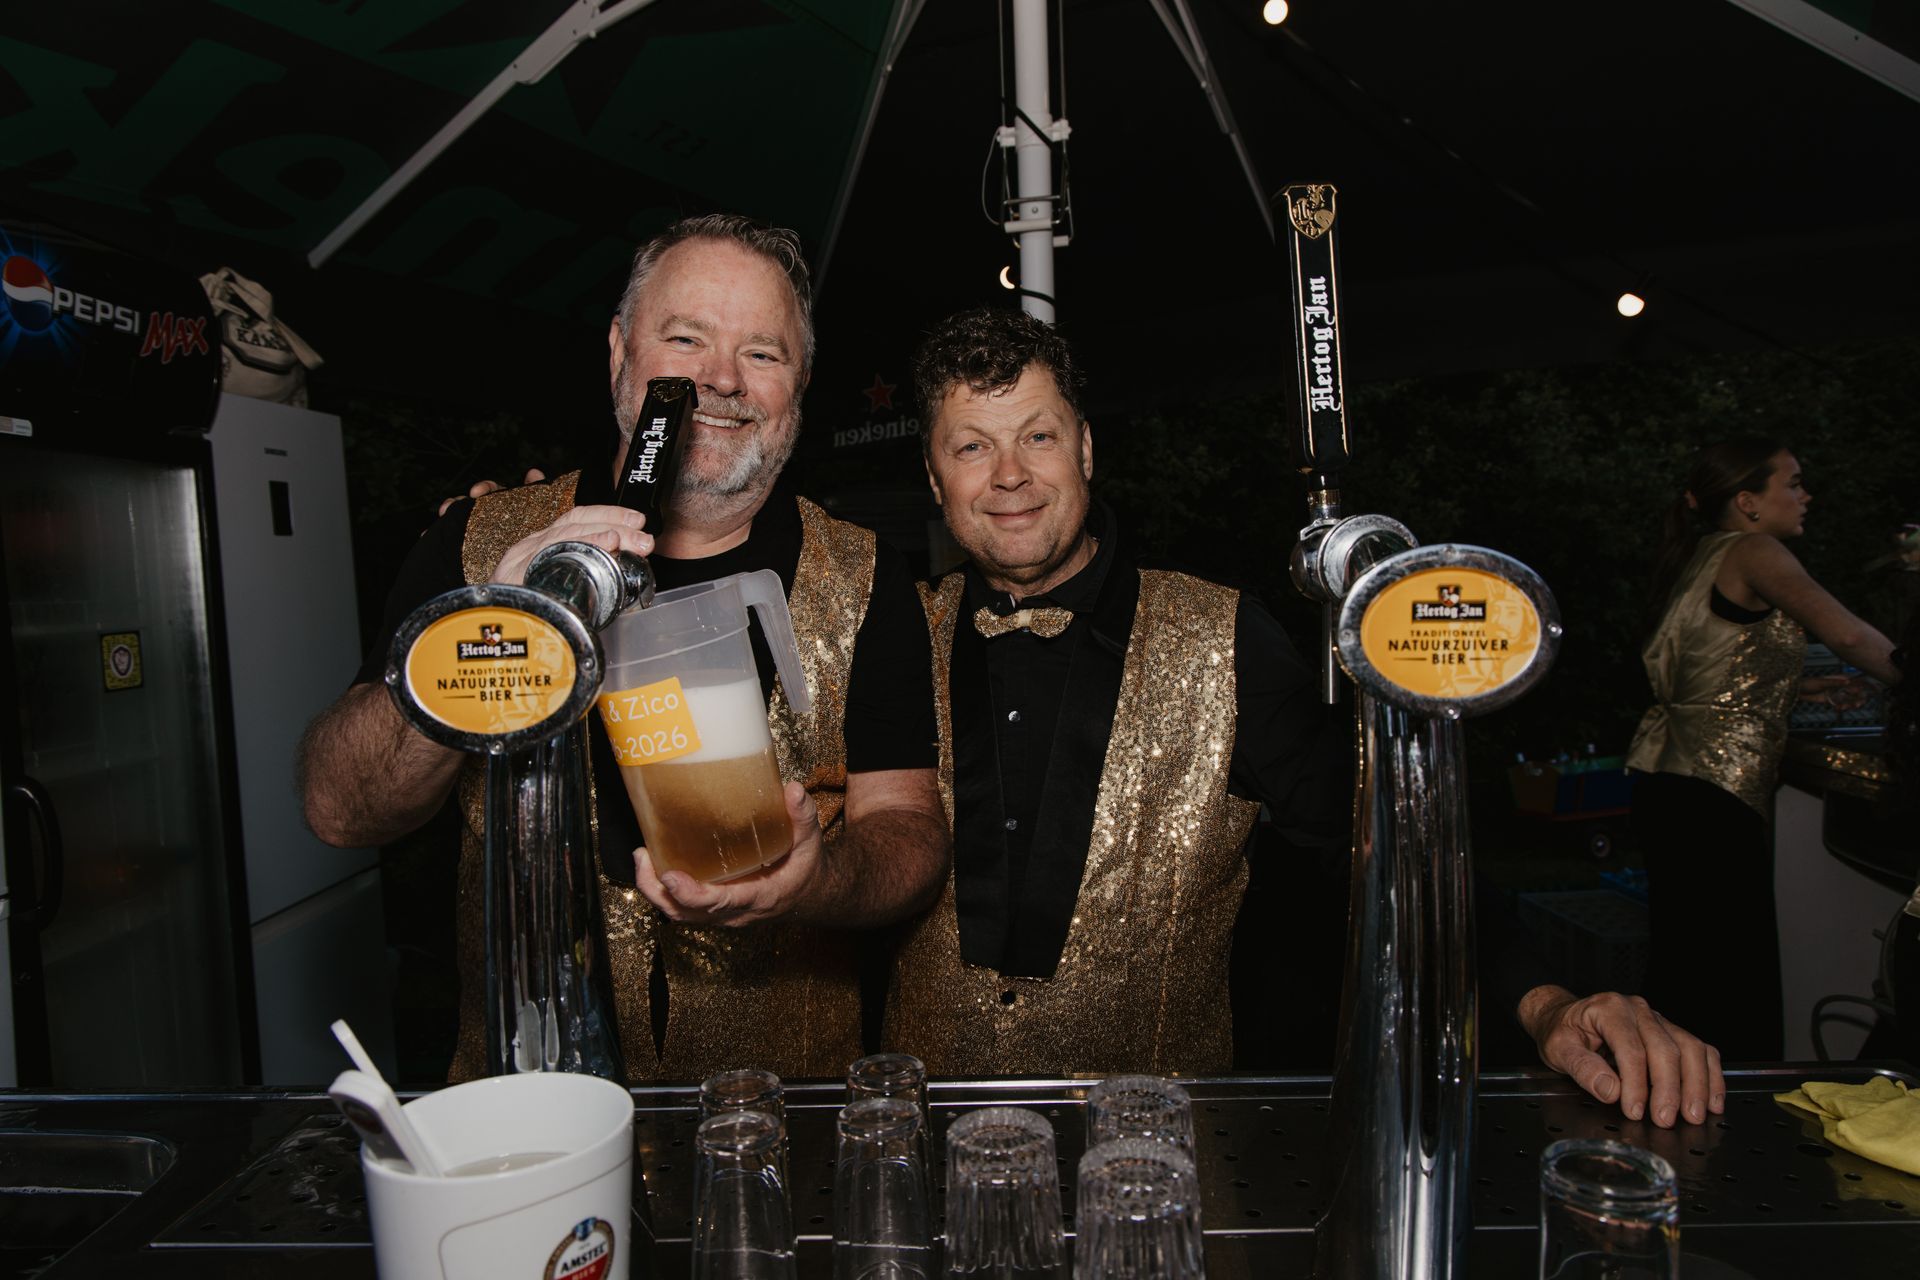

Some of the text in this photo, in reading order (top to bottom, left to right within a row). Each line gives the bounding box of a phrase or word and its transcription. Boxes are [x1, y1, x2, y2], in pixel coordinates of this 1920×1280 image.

[53, 285, 209, 365] PEPSI MAX
[1304, 275, 1341, 413] Hertog Jan
[628, 417, 669, 484] Hertog Jan
[1415, 603, 1484, 620] Hertog Jan
[1410, 629, 1487, 638] TRADITIONEEL
[460, 641, 526, 660] Hertog Jan
[1388, 639, 1510, 652] NATUURZUIVER
[1431, 653, 1467, 665] BIER
[457, 666, 530, 677] TRADITIONEEL
[437, 674, 553, 691] NATUURZUIVER
[480, 689, 513, 702] BIER
[608, 693, 679, 723] & Zico
[561, 1241, 607, 1274] AMSTEL
